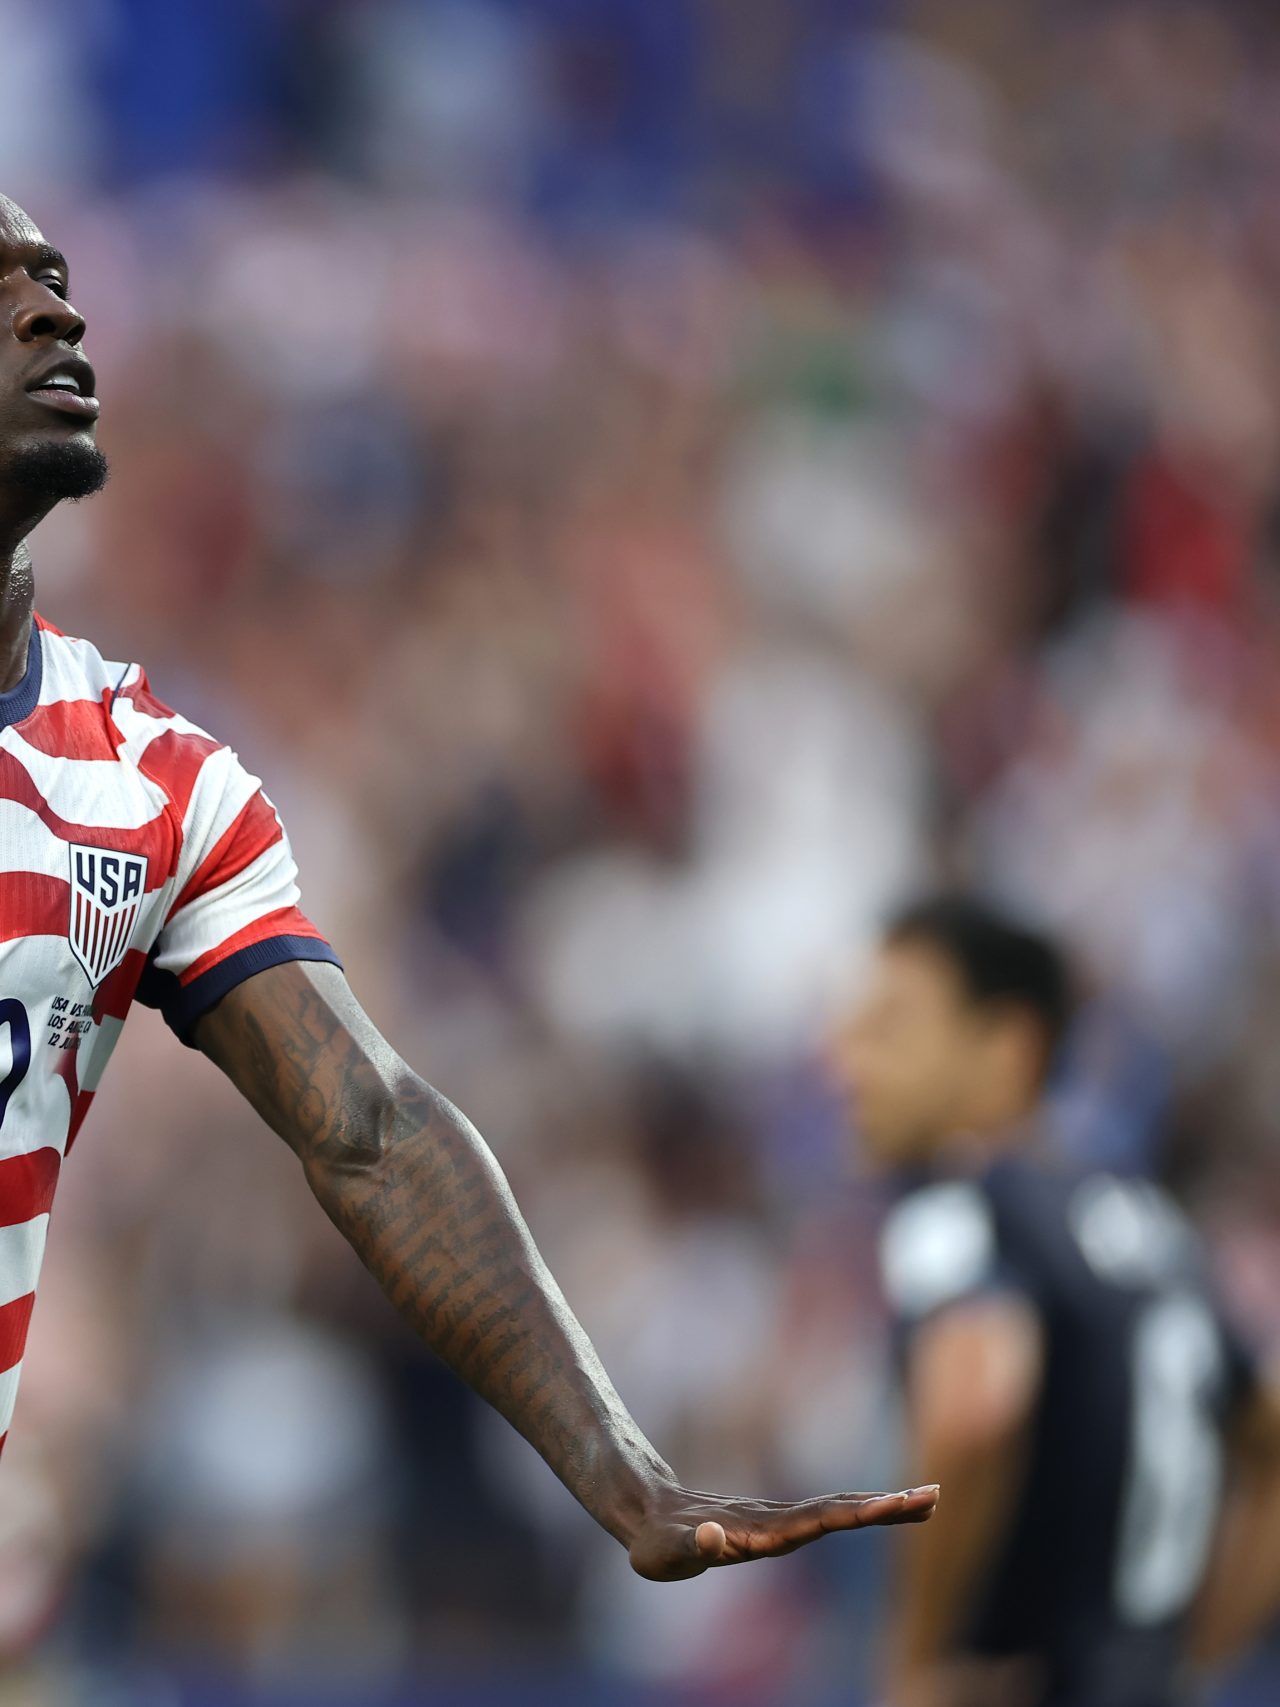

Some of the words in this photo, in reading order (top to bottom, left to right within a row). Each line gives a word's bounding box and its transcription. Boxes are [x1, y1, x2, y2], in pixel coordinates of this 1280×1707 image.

[76, 852, 142, 908] USA
[51, 996, 70, 1012] USA
[70, 1003, 84, 1017] VS
[47, 1014, 67, 1029] LOS
[48, 1033, 61, 1046] 12
